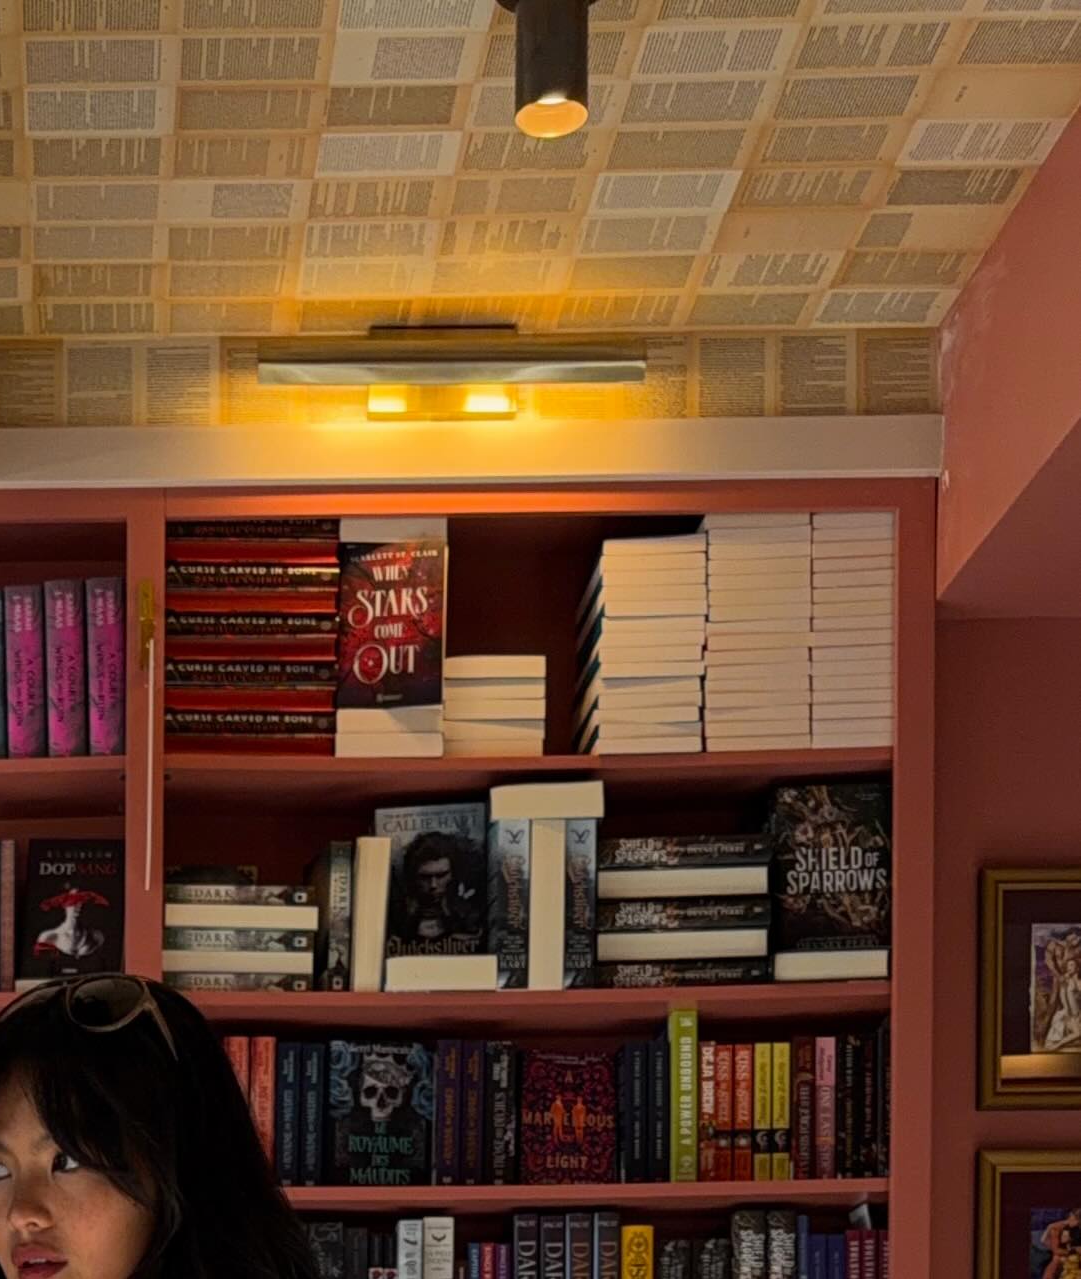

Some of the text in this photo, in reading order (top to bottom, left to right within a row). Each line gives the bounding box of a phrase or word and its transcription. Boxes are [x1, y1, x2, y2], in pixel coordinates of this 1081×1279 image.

[372, 564, 409, 582] WHEN
[348, 586, 434, 629] STARS
[180, 616, 215, 625] CURSE
[221, 616, 266, 625] CARVED
[374, 622, 405, 640] COME
[179, 664, 214, 673] CURSE
[219, 664, 265, 673] CARVED
[353, 643, 420, 685] OUT
[178, 714, 213, 722] CURSE
[218, 714, 264, 722] CARVED
[382, 815, 478, 834] CALLIE HART
[618, 838, 655, 850] SHIELD
[795, 847, 879, 872] SHIELD OF
[786, 868, 887, 895] SPARROWS
[194, 888, 234, 899] DARK
[619, 902, 655, 914] SHIELD
[194, 932, 234, 943] DARK
[617, 964, 653, 976] SHIELD
[193, 976, 233, 986] DARK
[680, 1037, 692, 1097] UNBOUND
[521, 1110, 615, 1129] MAREOUS
[680, 1100, 692, 1136] POWER
[546, 1152, 590, 1169] LIGHT
[350, 1167, 411, 1186] MAUDITS
